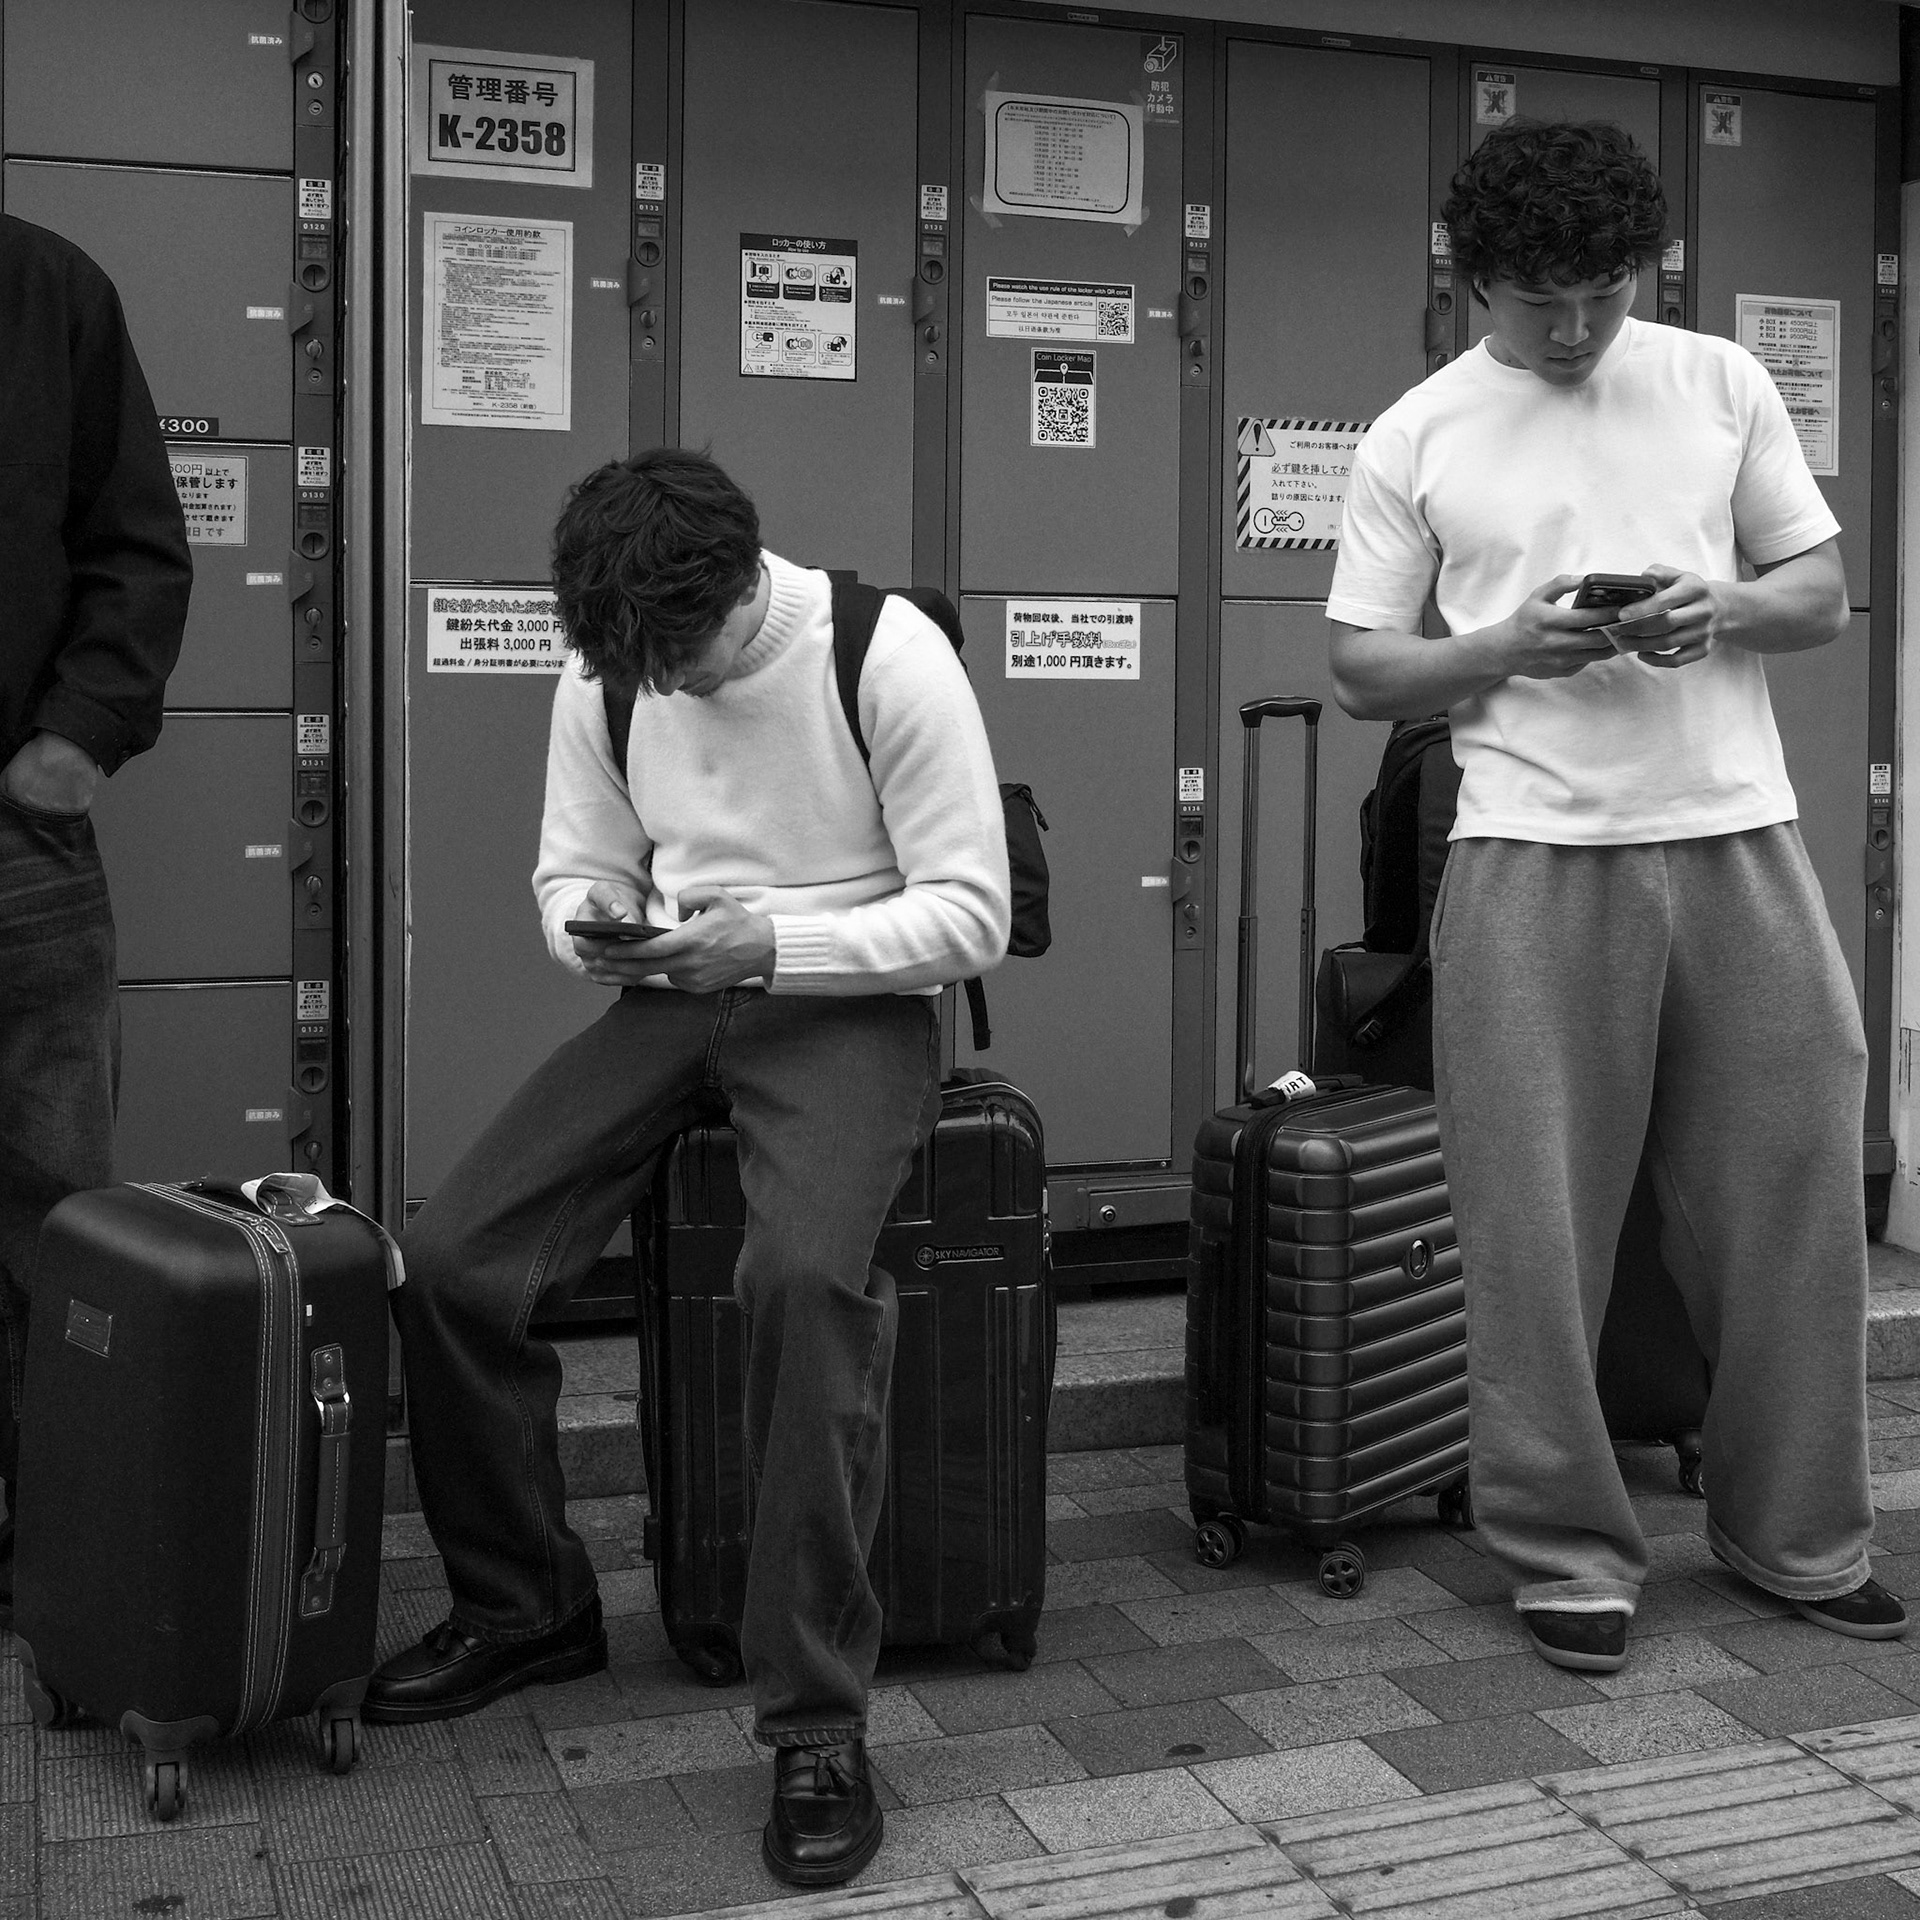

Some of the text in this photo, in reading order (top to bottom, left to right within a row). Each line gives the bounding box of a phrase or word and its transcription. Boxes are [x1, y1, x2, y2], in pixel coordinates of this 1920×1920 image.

[447, 73, 558, 107] 管理番号
[1151, 81, 1169, 92] 防犯
[1147, 93, 1173, 104] カメラ
[1147, 103, 1174, 114] 作動中
[439, 113, 566, 156] K-2358
[454, 226, 541, 238] コインロッカー使用約款
[772, 238, 827, 250] ロッカーの使い方
[993, 282, 1010, 290] Please
[1013, 296, 1030, 304] follow
[1044, 298, 1072, 307] Japanese
[1020, 311, 1039, 319] 일본어
[1053, 354, 1076, 362] Locker
[1077, 355, 1092, 363] Map
[205, 468, 230, 477] 以上で
[1271, 480, 1318, 489] 入れて下さい。
[302, 491, 325, 499] 0130
[205, 527, 225, 537] です
[446, 618, 514, 632] 鍵紛失代金
[517, 620, 549, 633] 3,000
[460, 637, 551, 652] 出張料 3,000 円
[1010, 630, 1103, 649] 引上げ手数料
[473, 659, 567, 668] 身分証明書が必要になりま
[302, 759, 324, 767] 0131
[301, 1026, 324, 1034] 0132
